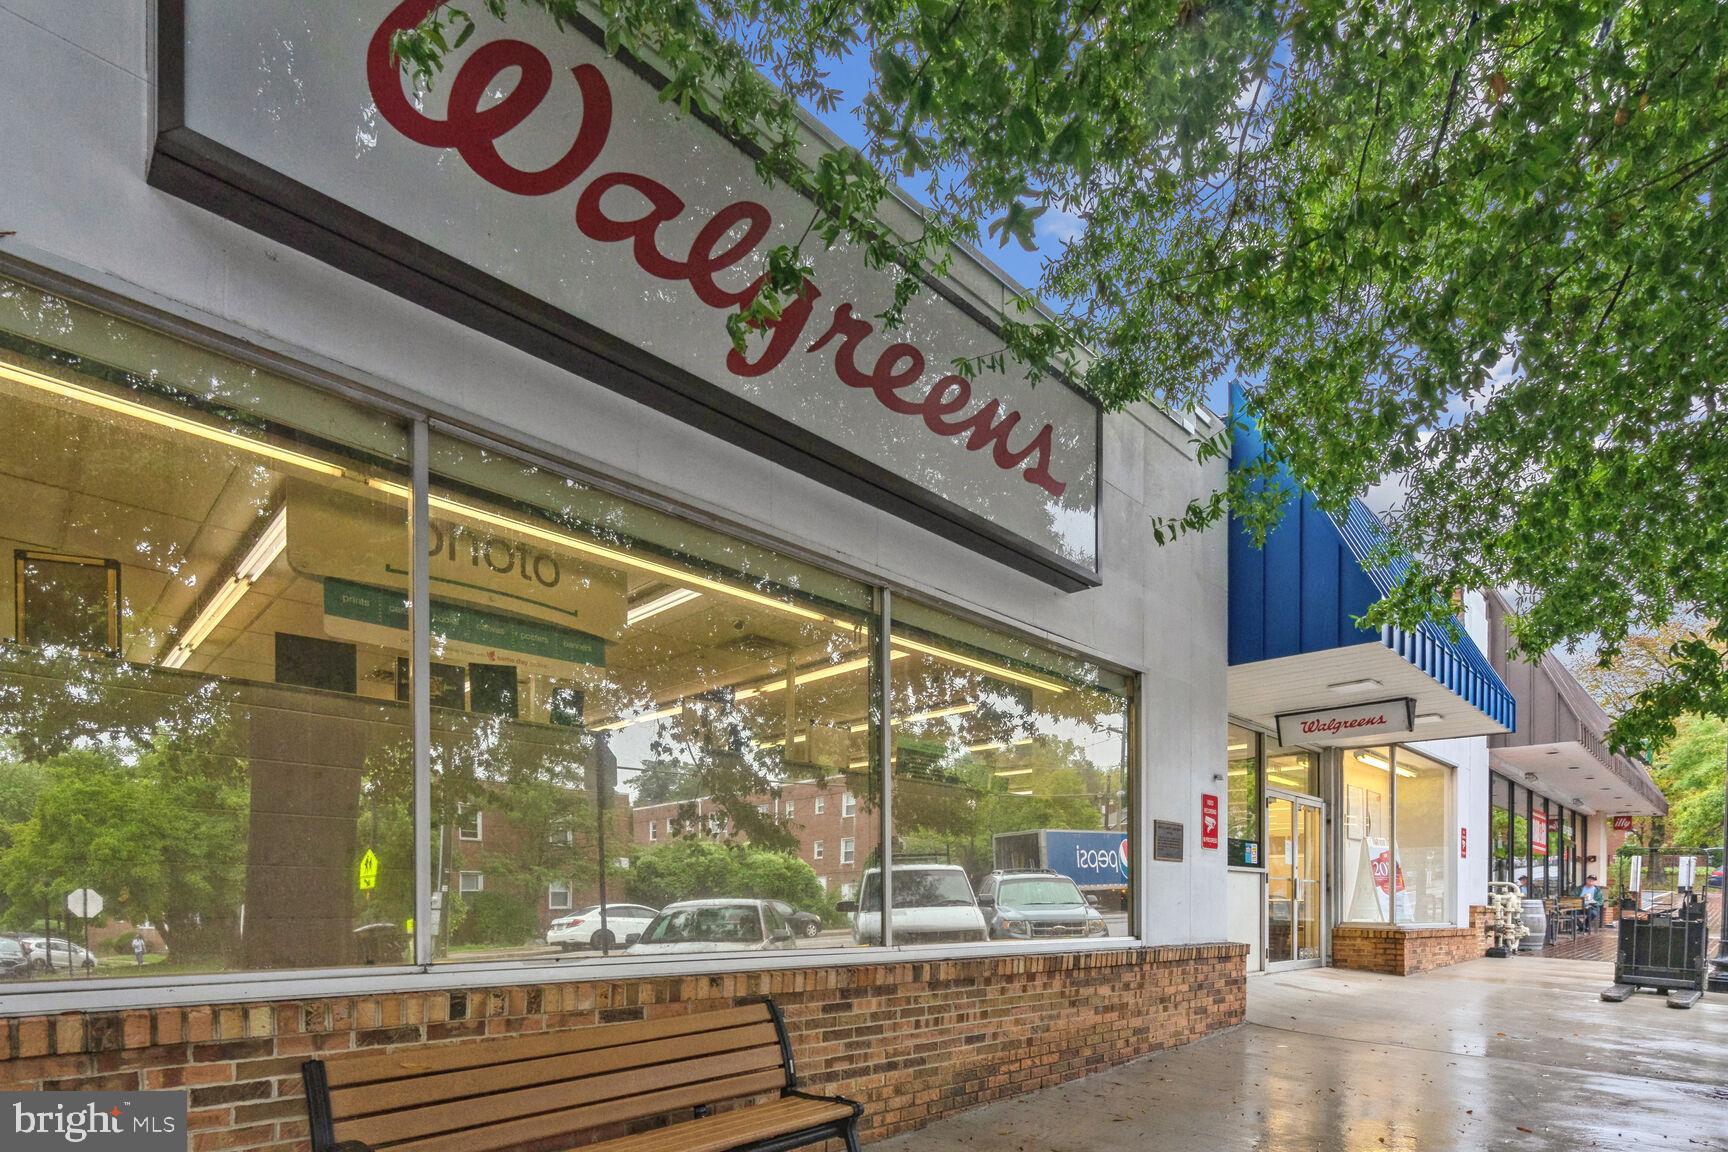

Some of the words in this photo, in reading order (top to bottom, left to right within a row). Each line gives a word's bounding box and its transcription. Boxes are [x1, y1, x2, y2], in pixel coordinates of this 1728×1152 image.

[367, 0, 1066, 496] Walgreens
[1300, 715, 1387, 735] Walgreens
[1615, 818, 1631, 828] illy
